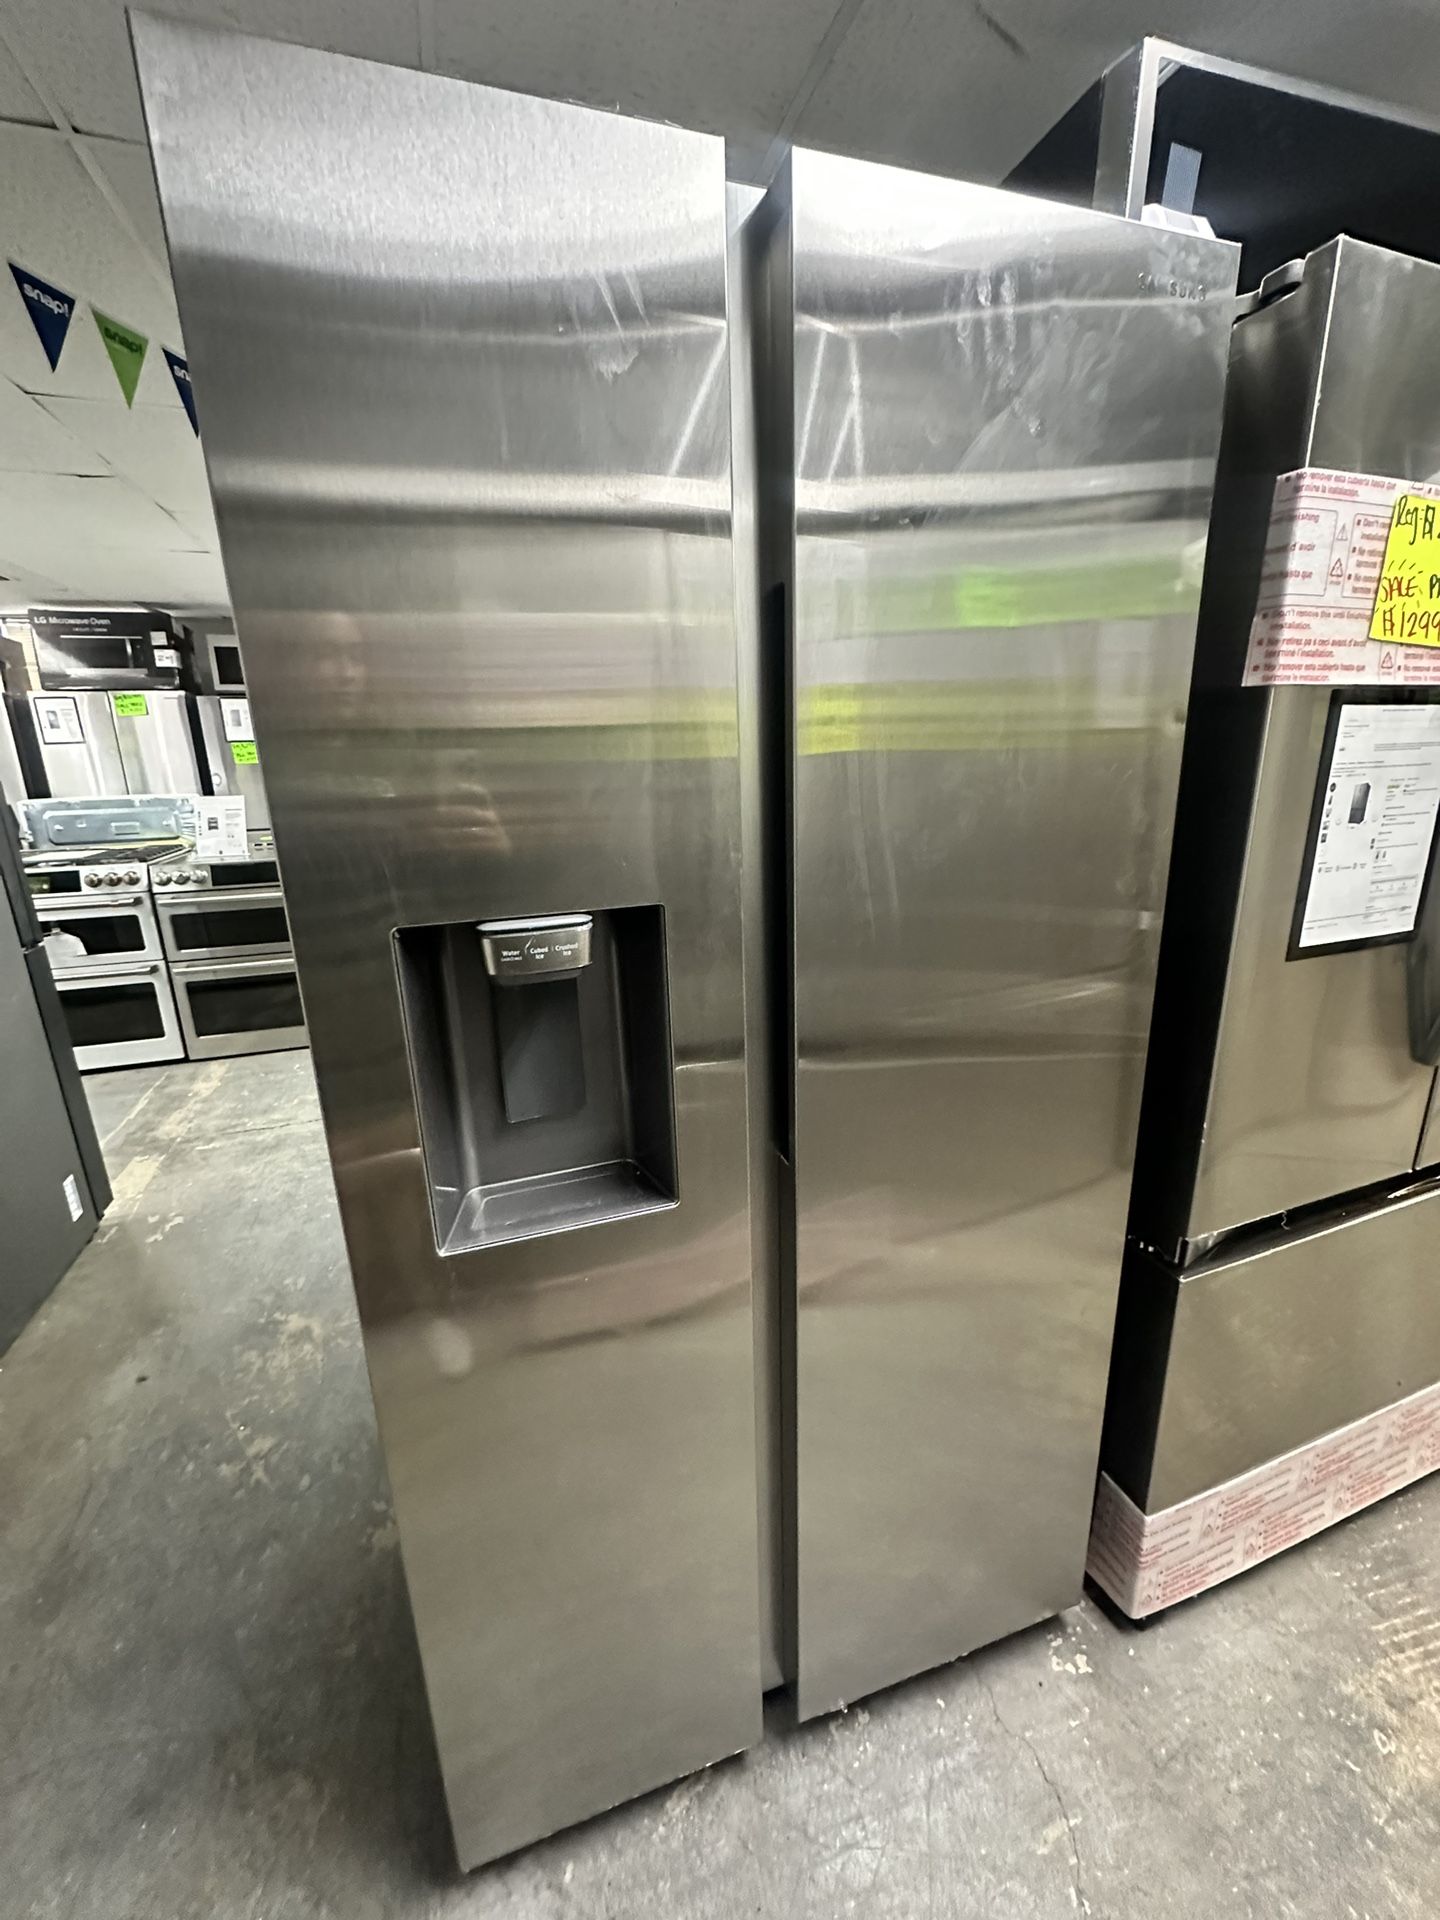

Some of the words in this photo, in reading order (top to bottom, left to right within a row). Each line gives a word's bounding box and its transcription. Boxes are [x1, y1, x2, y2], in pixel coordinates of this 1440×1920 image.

[23, 283, 69, 317] snap!
[1136, 271, 1206, 301] SASUNG
[104, 326, 143, 355] snap!
[1380, 575, 1418, 603] SALE
[33, 616, 47, 624] LG
[48, 616, 89, 625] Microwave
[90, 617, 111, 625] Oven
[530, 946, 549, 954] Cubed
[555, 942, 579, 952] Crushed
